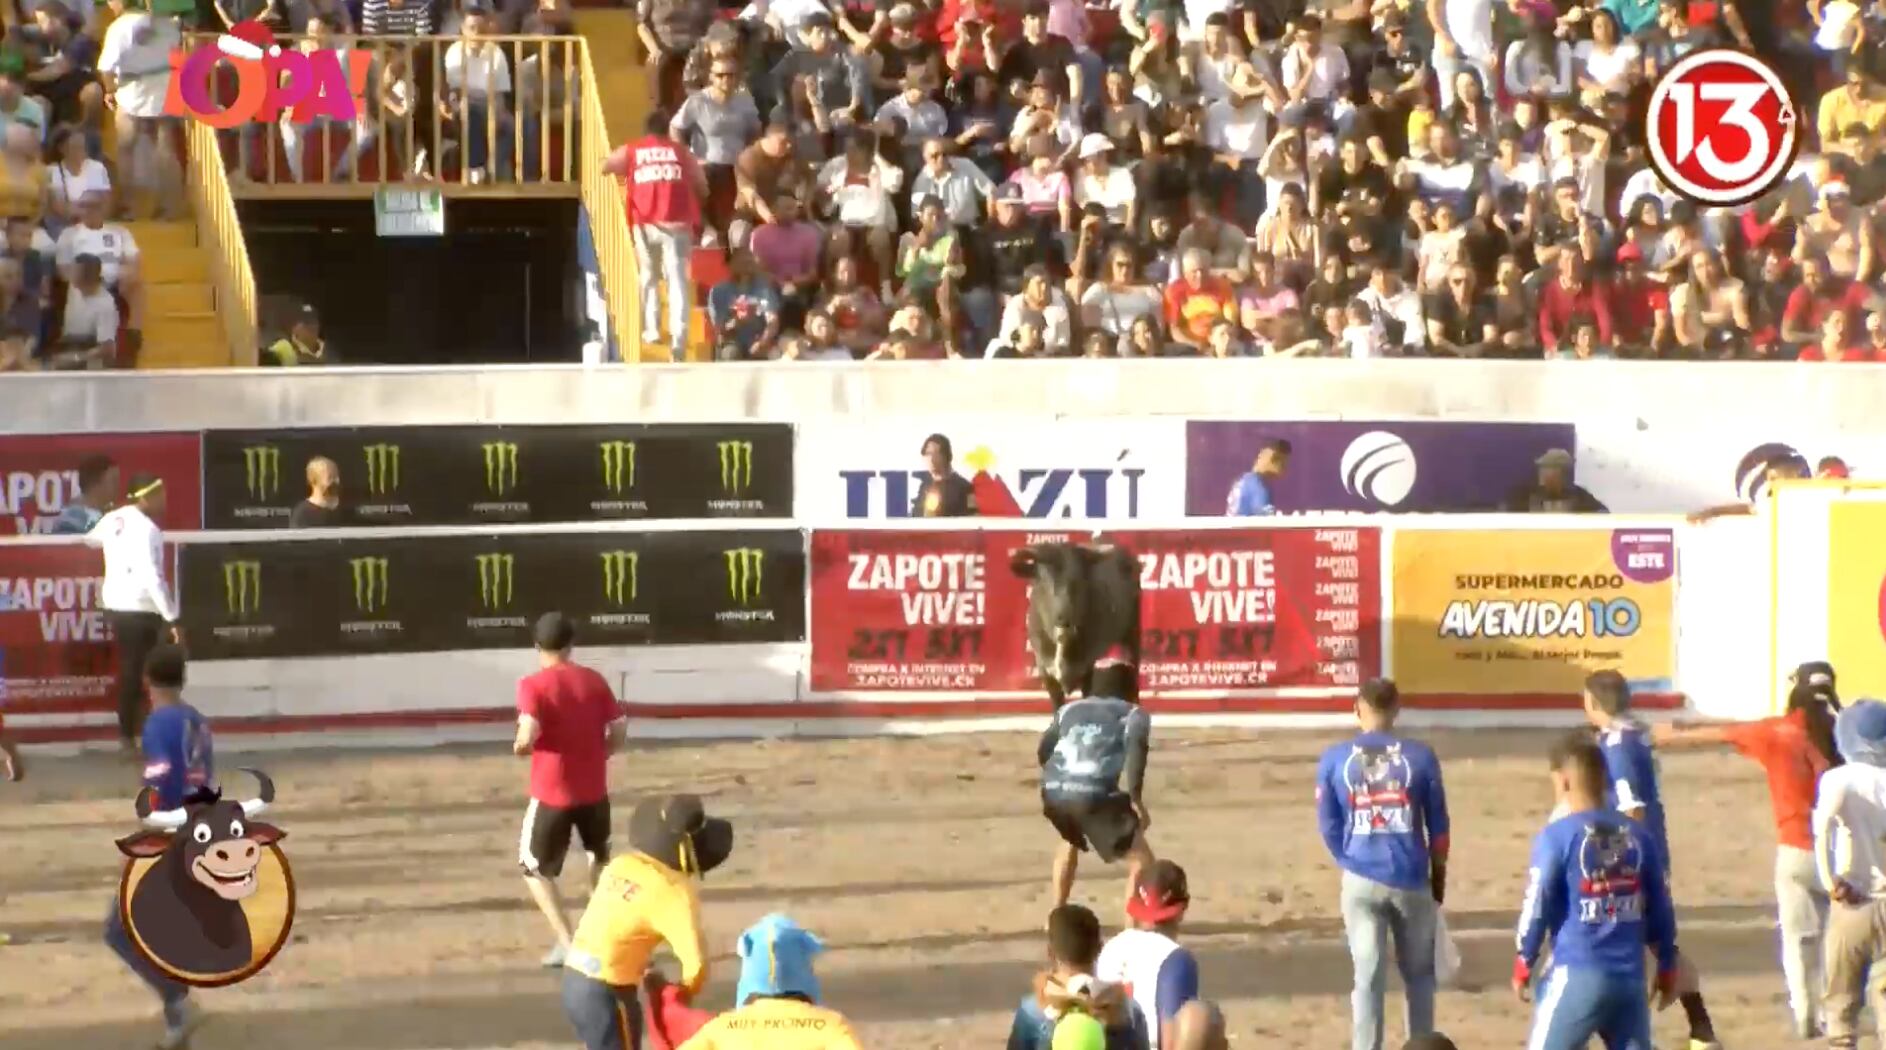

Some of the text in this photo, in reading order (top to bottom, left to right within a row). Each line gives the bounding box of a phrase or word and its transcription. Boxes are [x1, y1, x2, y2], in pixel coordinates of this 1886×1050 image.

[848, 554, 986, 590] ZAPOTE
[1138, 551, 1275, 590] ZAPOTE
[1455, 574, 1625, 590] SUPERMERCADO
[901, 592, 986, 625] VIVE!
[1190, 589, 1276, 624] VIVE!
[1438, 597, 1642, 638] AVENIDA 10
[1148, 672, 1269, 686] ZAPOTEVIVE.CR
